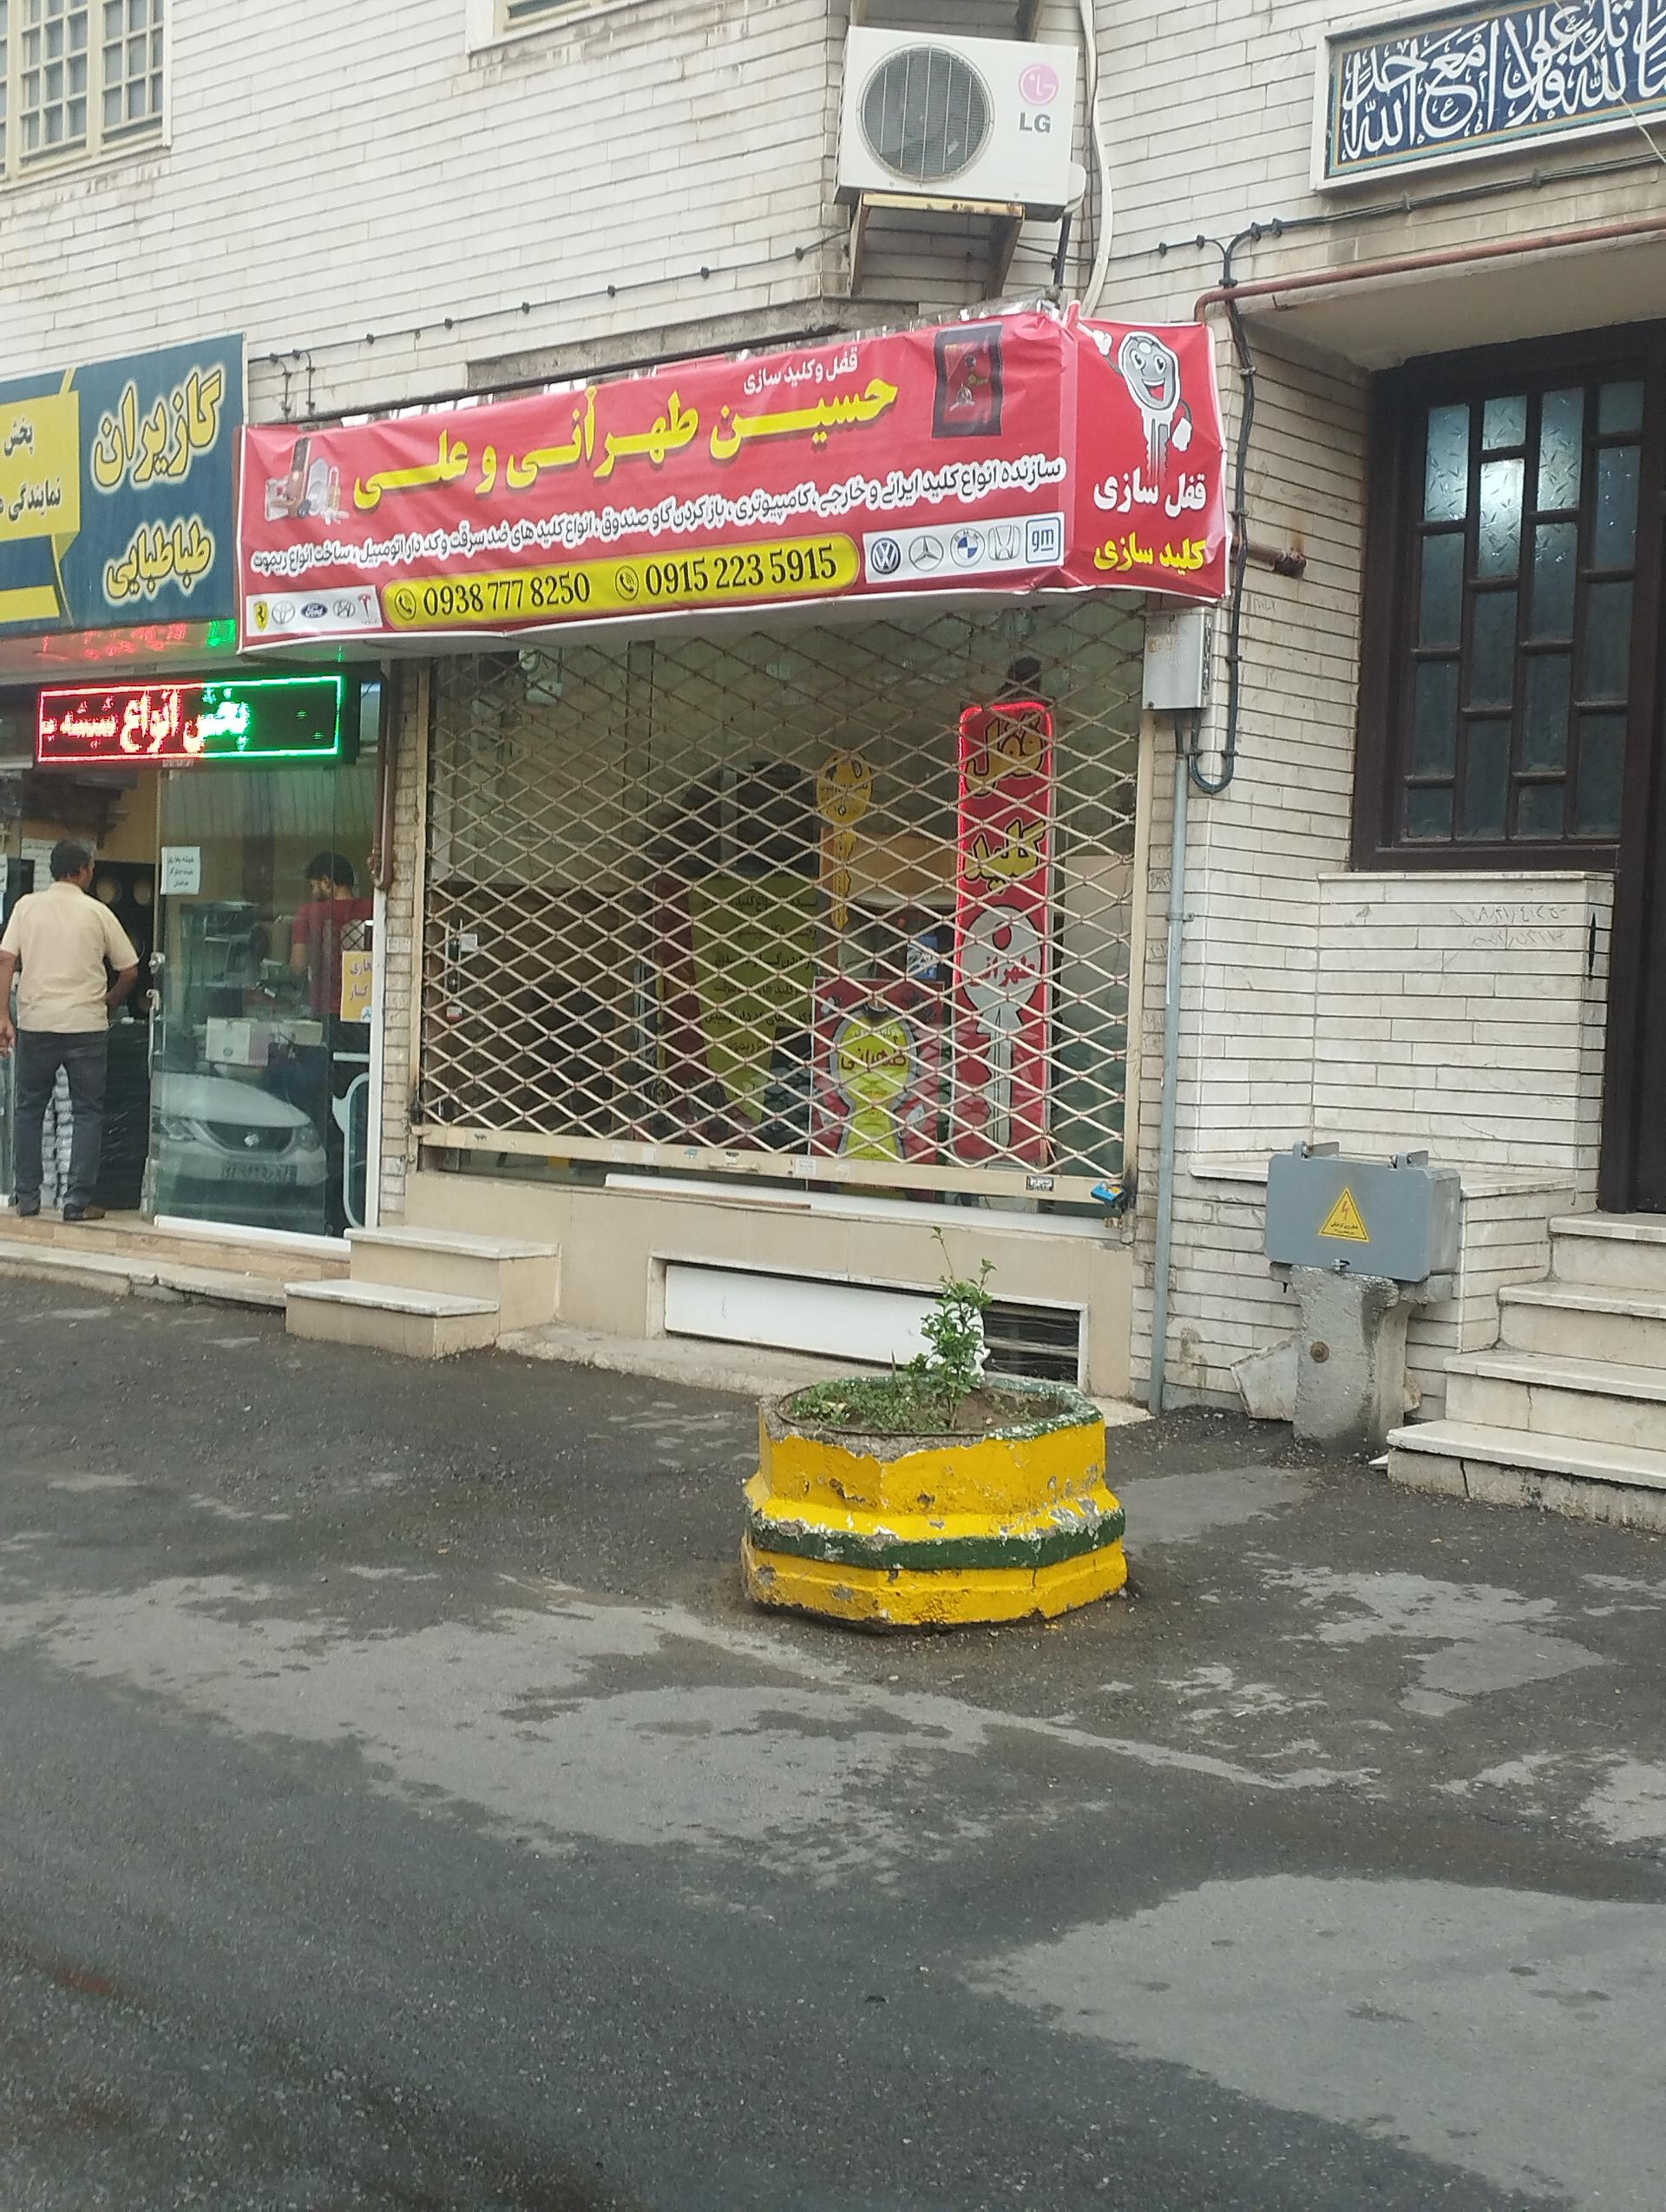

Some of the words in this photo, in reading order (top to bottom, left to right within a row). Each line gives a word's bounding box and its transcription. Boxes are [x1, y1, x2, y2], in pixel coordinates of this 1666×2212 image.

[1019, 112, 1051, 134] LG
[784, 358, 816, 387] کلید
[826, 347, 858, 382] قفل
[744, 368, 781, 395] سازی
[710, 378, 898, 459] حسین
[3, 416, 33, 456] پخش
[507, 386, 699, 488] طهرانی
[353, 429, 469, 510] علی
[475, 446, 497, 494] و
[923, 468, 958, 498] کلید
[961, 461, 997, 495] انواع
[1001, 457, 1060, 488] سازنده
[9, 477, 61, 521] نمایندگی
[882, 473, 918, 501] ایرانی
[1093, 467, 1158, 513] سازی
[1165, 473, 1207, 517] قفل
[566, 514, 593, 543] انواع
[674, 499, 705, 528] کردن
[406, 533, 422, 561] دار
[450, 522, 485, 552] سرقت
[488, 523, 508, 543] ضد
[510, 522, 535, 547] های
[537, 518, 565, 544] کلید
[1032, 528, 1054, 553] gm
[108, 521, 213, 599] طباطبایی
[253, 553, 288, 574] ریموت
[289, 545, 313, 572] انواع
[314, 541, 349, 564] ساخت
[1093, 532, 1154, 572] سازی
[1159, 538, 1206, 576] کلید
[645, 560, 709, 597] 0915
[715, 553, 765, 588] 223
[770, 543, 837, 584] 5915
[423, 582, 483, 617] 0938
[487, 579, 524, 612] 777
[530, 572, 591, 607] 8250
[120, 685, 182, 754] انواع
[964, 818, 1046, 897] کلید
